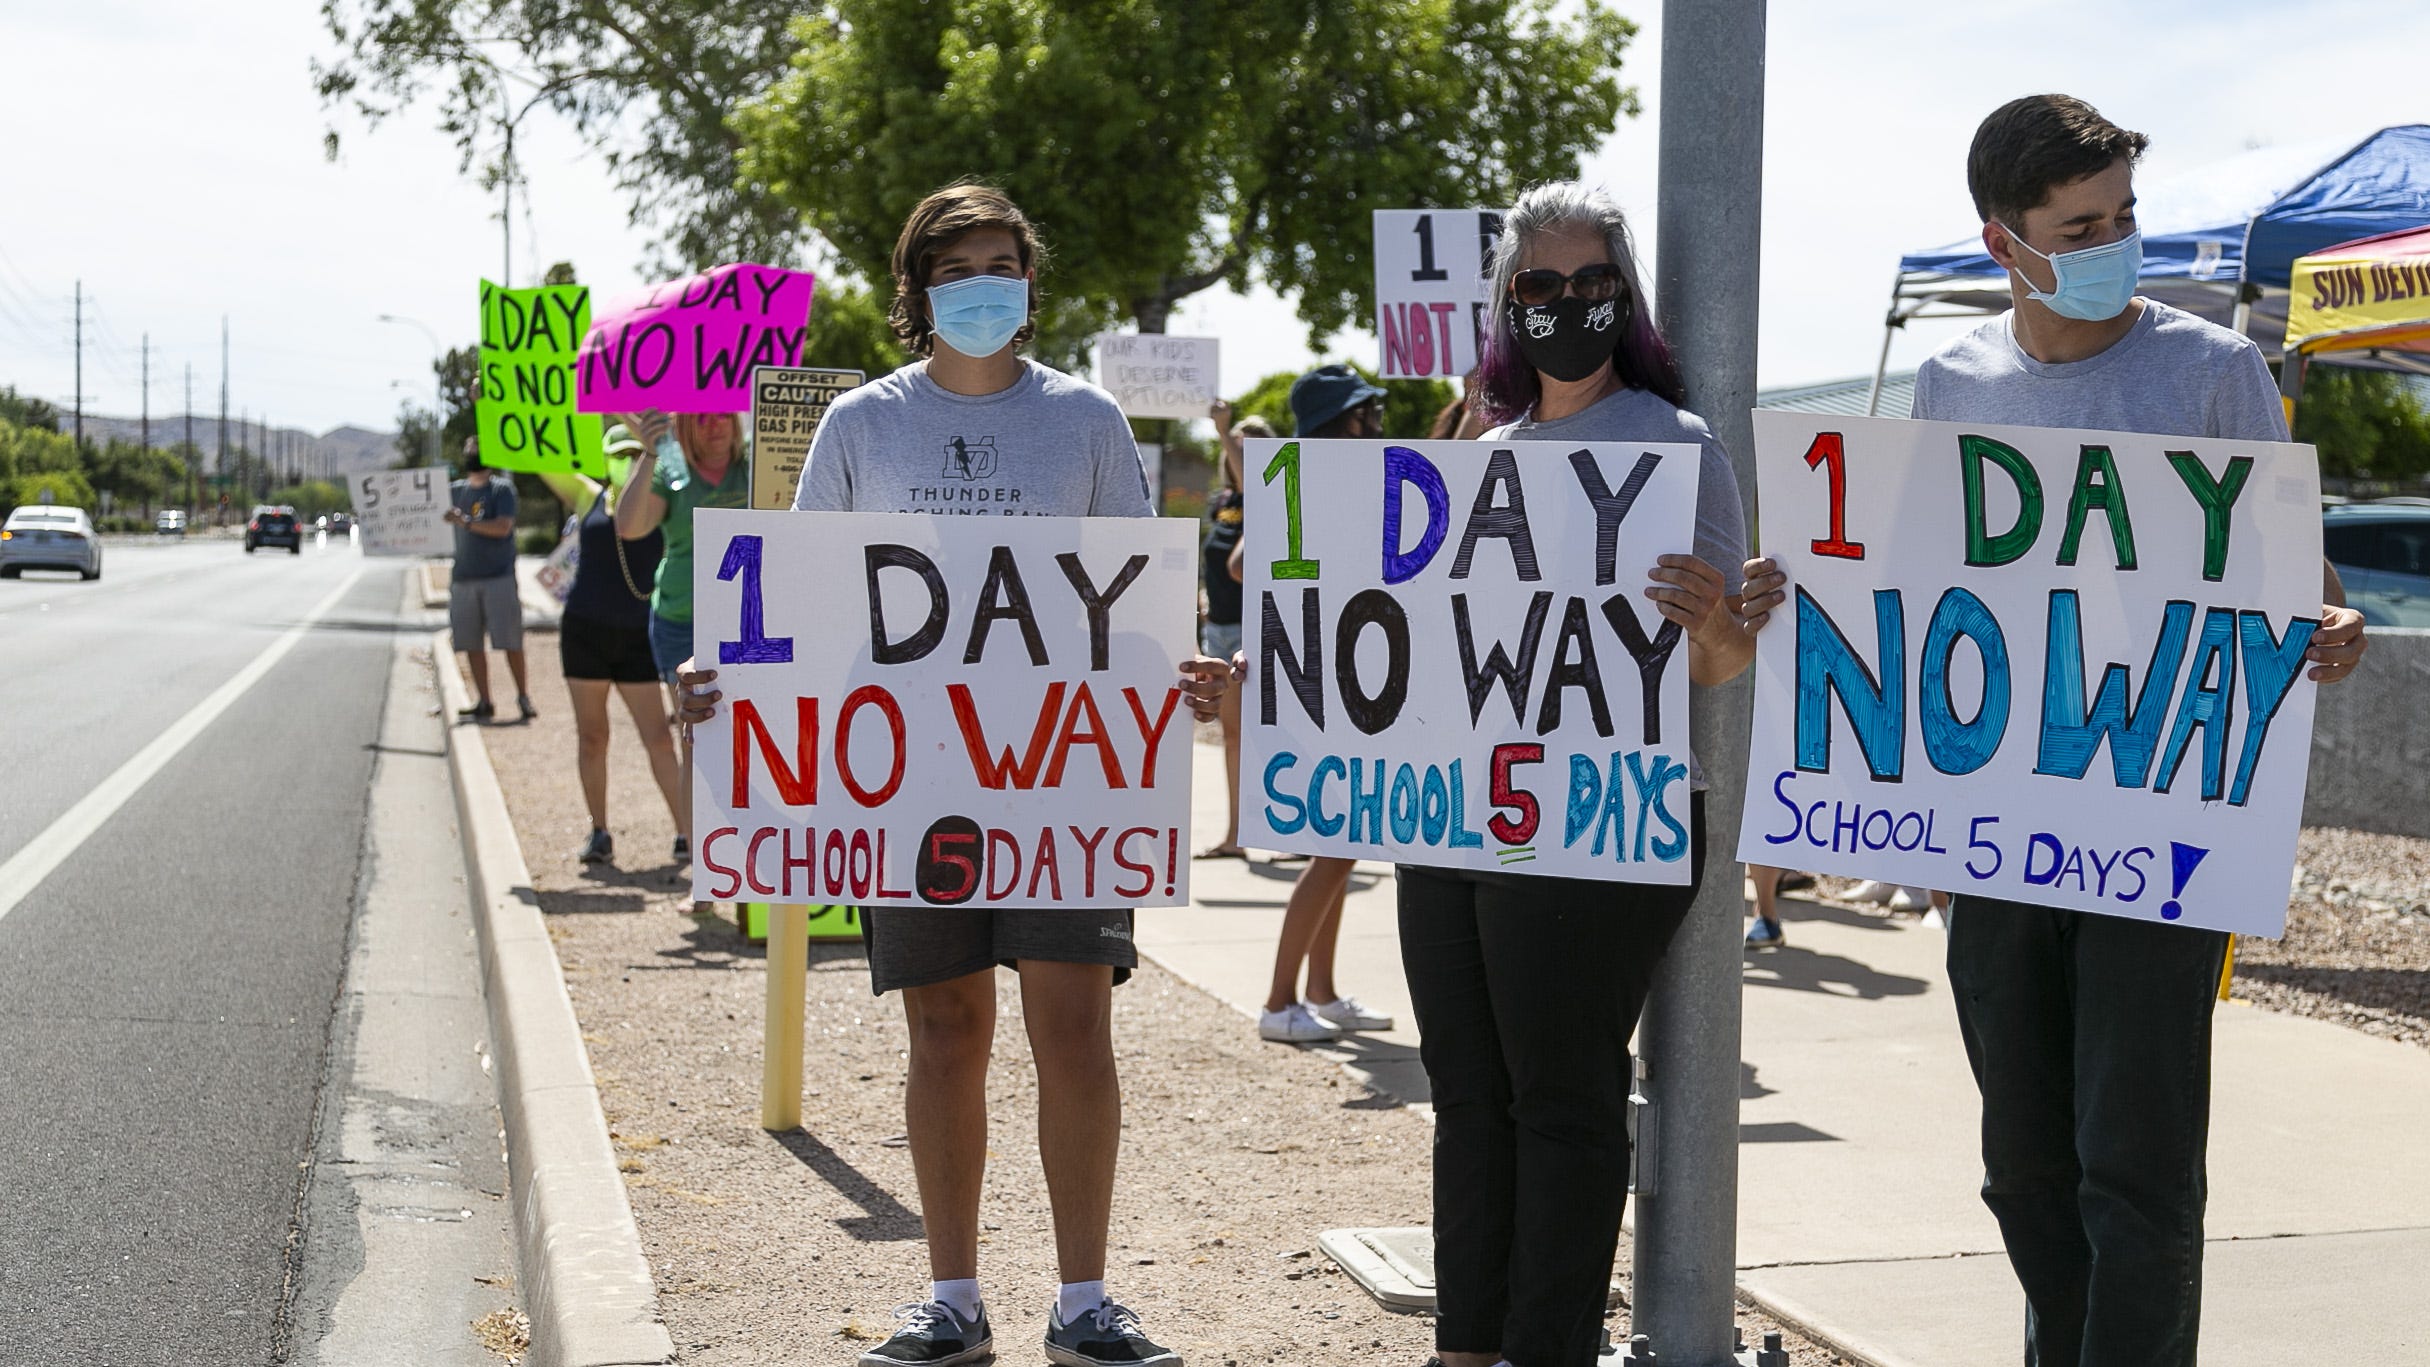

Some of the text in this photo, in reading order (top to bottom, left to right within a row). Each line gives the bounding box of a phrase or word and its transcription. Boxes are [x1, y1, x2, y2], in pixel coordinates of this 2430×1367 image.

[1411, 214, 1448, 281] 1
[677, 271, 790, 315] DAY
[2312, 261, 2430, 311] SUN DEVI
[1383, 302, 1457, 377] NOT
[1526, 308, 1557, 338] Stay
[584, 322, 807, 395] NO WAY
[777, 372, 839, 384] OFFSET
[759, 405, 790, 418] HIGH
[759, 418, 818, 434] GAS PIP
[764, 386, 847, 403] CAUTIO
[500, 412, 582, 469] OK!
[362, 470, 432, 509] 5 4
[909, 488, 1022, 502] THUNDER
[1263, 442, 1663, 586] 1 DAY
[1803, 431, 2254, 582] 1 DAY
[717, 535, 1150, 671] 1 DAY
[1261, 587, 1686, 746] NO WAY
[1794, 582, 2321, 807] NO WAY
[732, 681, 1182, 809] NO WAY
[1263, 743, 1689, 863] SCHOOL 5 DAYS
[1764, 771, 1947, 854] SCHOOL
[1965, 816, 2003, 880] 5
[702, 825, 1179, 901] SCHOOL 5 DAYS!
